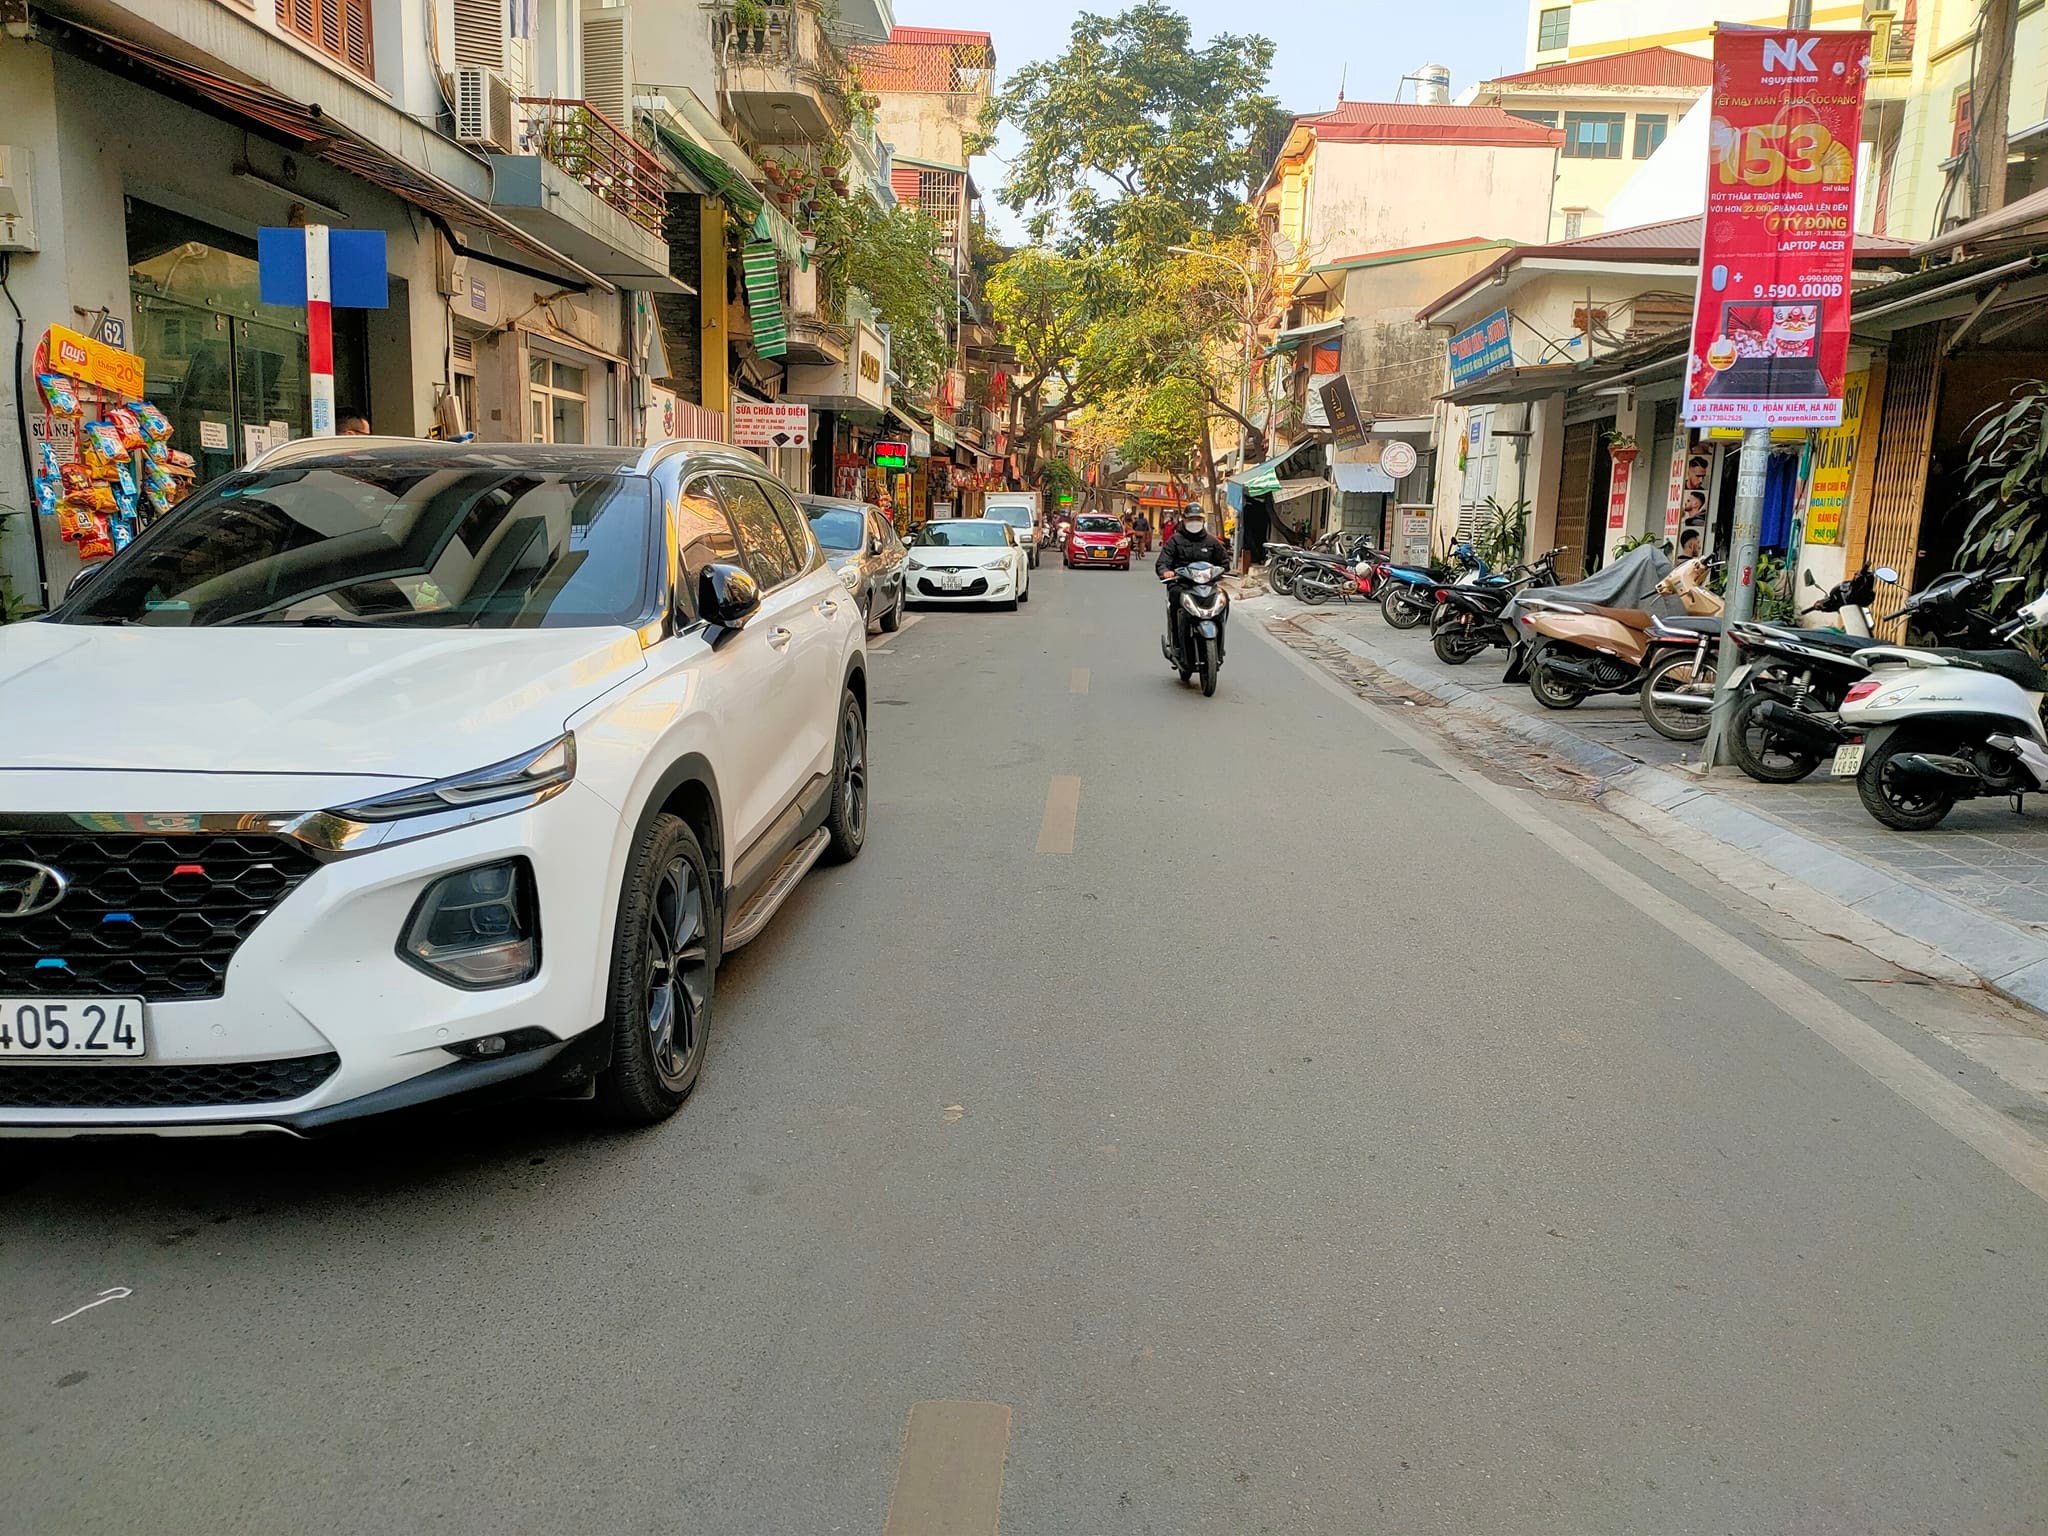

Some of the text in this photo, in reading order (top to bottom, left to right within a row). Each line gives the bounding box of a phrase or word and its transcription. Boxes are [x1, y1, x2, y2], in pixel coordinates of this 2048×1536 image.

[1762, 37, 1821, 72] NK
[1719, 123, 1832, 187] 153
[1771, 218, 1781, 230] 7
[1777, 241, 1845, 251] LAPTOP ACER
[1753, 284, 1843, 298] 9.590.000Đ
[104, 321, 121, 345] 62
[61, 341, 86, 362] Lay's
[117, 364, 133, 382] 20
[1778, 414, 1836, 423] nguyenkim.com
